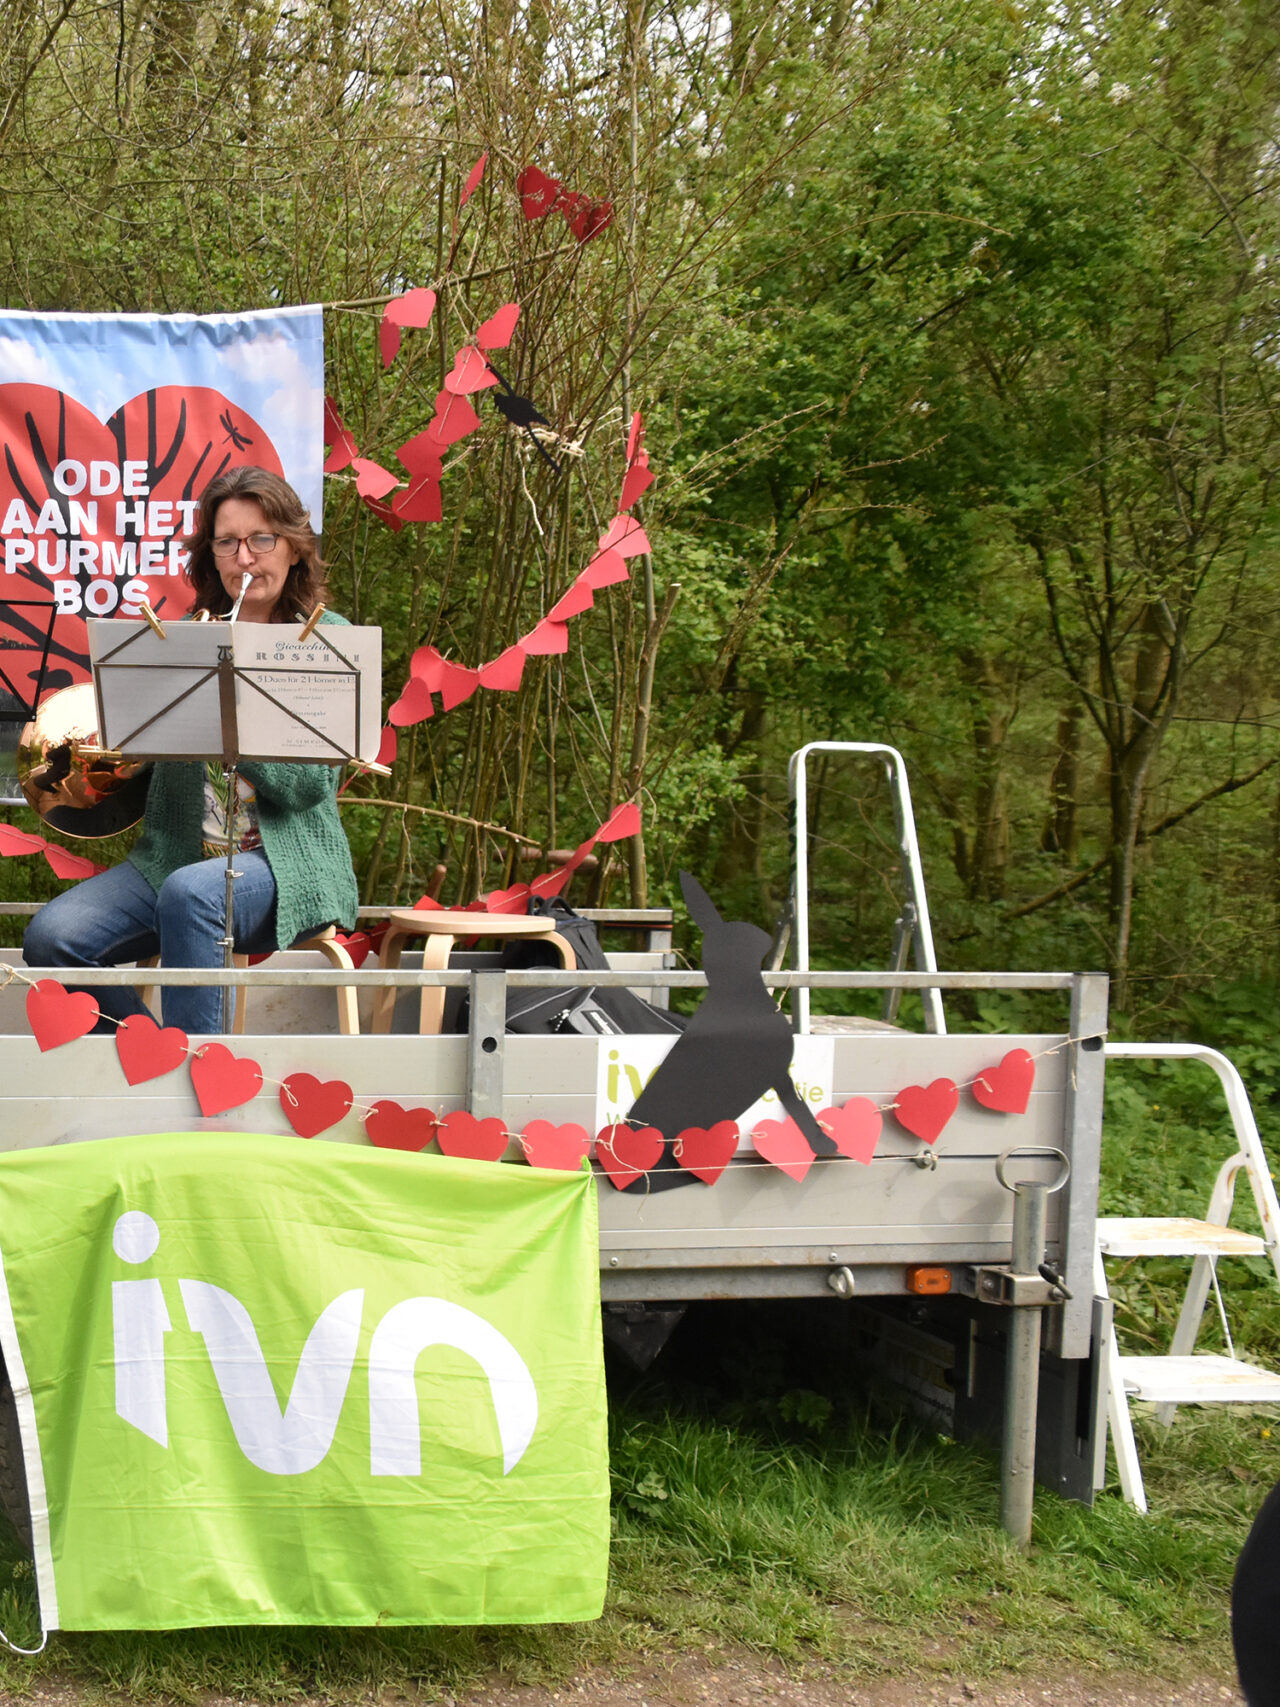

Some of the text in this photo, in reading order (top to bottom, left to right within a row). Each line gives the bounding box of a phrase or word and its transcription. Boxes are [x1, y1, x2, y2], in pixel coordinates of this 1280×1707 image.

[53, 458, 150, 496] ODE
[0, 498, 200, 536] AAN HET
[4, 538, 192, 577] PURMER
[53, 578, 151, 616] BOS
[256, 652, 360, 663] ROSSII
[275, 640, 331, 653] Gioacchin
[607, 1049, 663, 1104] iv
[111, 1210, 539, 1476] ivn
